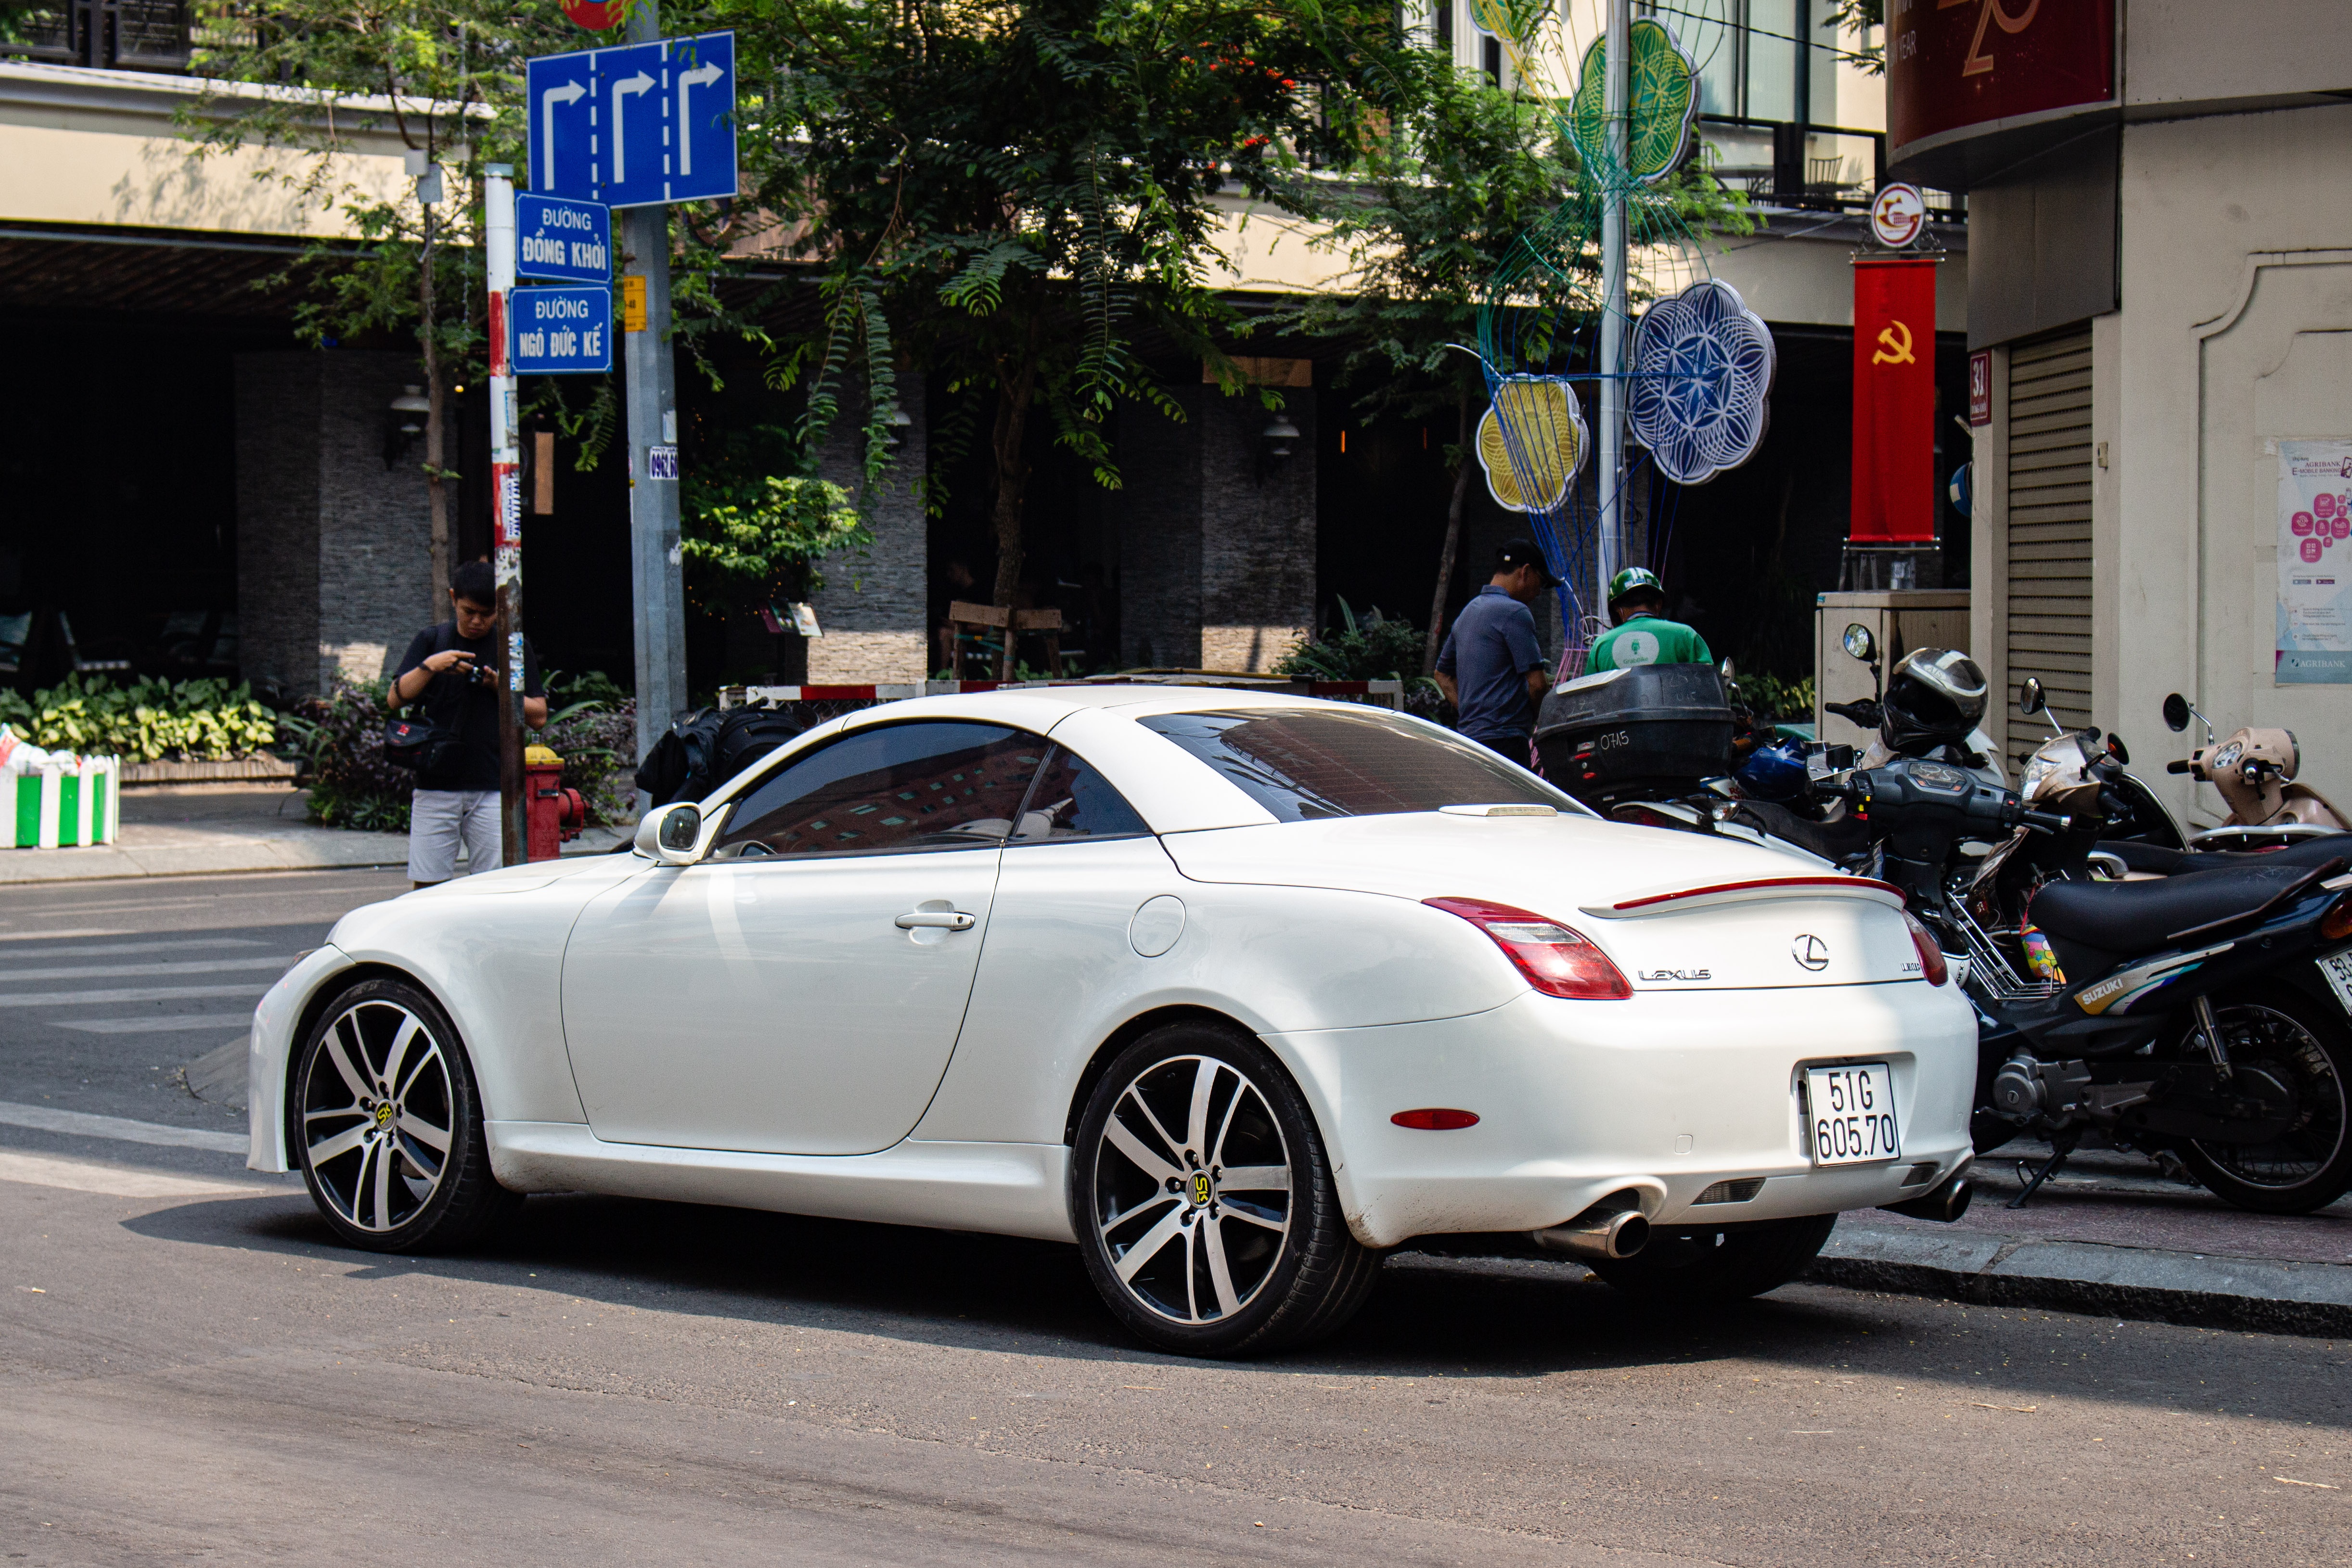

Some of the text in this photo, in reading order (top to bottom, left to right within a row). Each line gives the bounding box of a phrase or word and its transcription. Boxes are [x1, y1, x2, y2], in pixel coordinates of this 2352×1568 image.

[542, 206, 592, 231] ĐƯỜNG
[522, 227, 606, 271] ĐỒNG KHỞI
[536, 296, 589, 320] ĐƯỜNG
[519, 322, 603, 358] NGÔ ĐỨC KẾ
[1974, 360, 1985, 398] 31
[1601, 731, 1629, 750] 0715
[1638, 970, 1711, 981] LEXUS
[2082, 978, 2123, 1005] SUZUKI
[1829, 1070, 1873, 1112] 51G
[1817, 1114, 1895, 1159] 605.70
